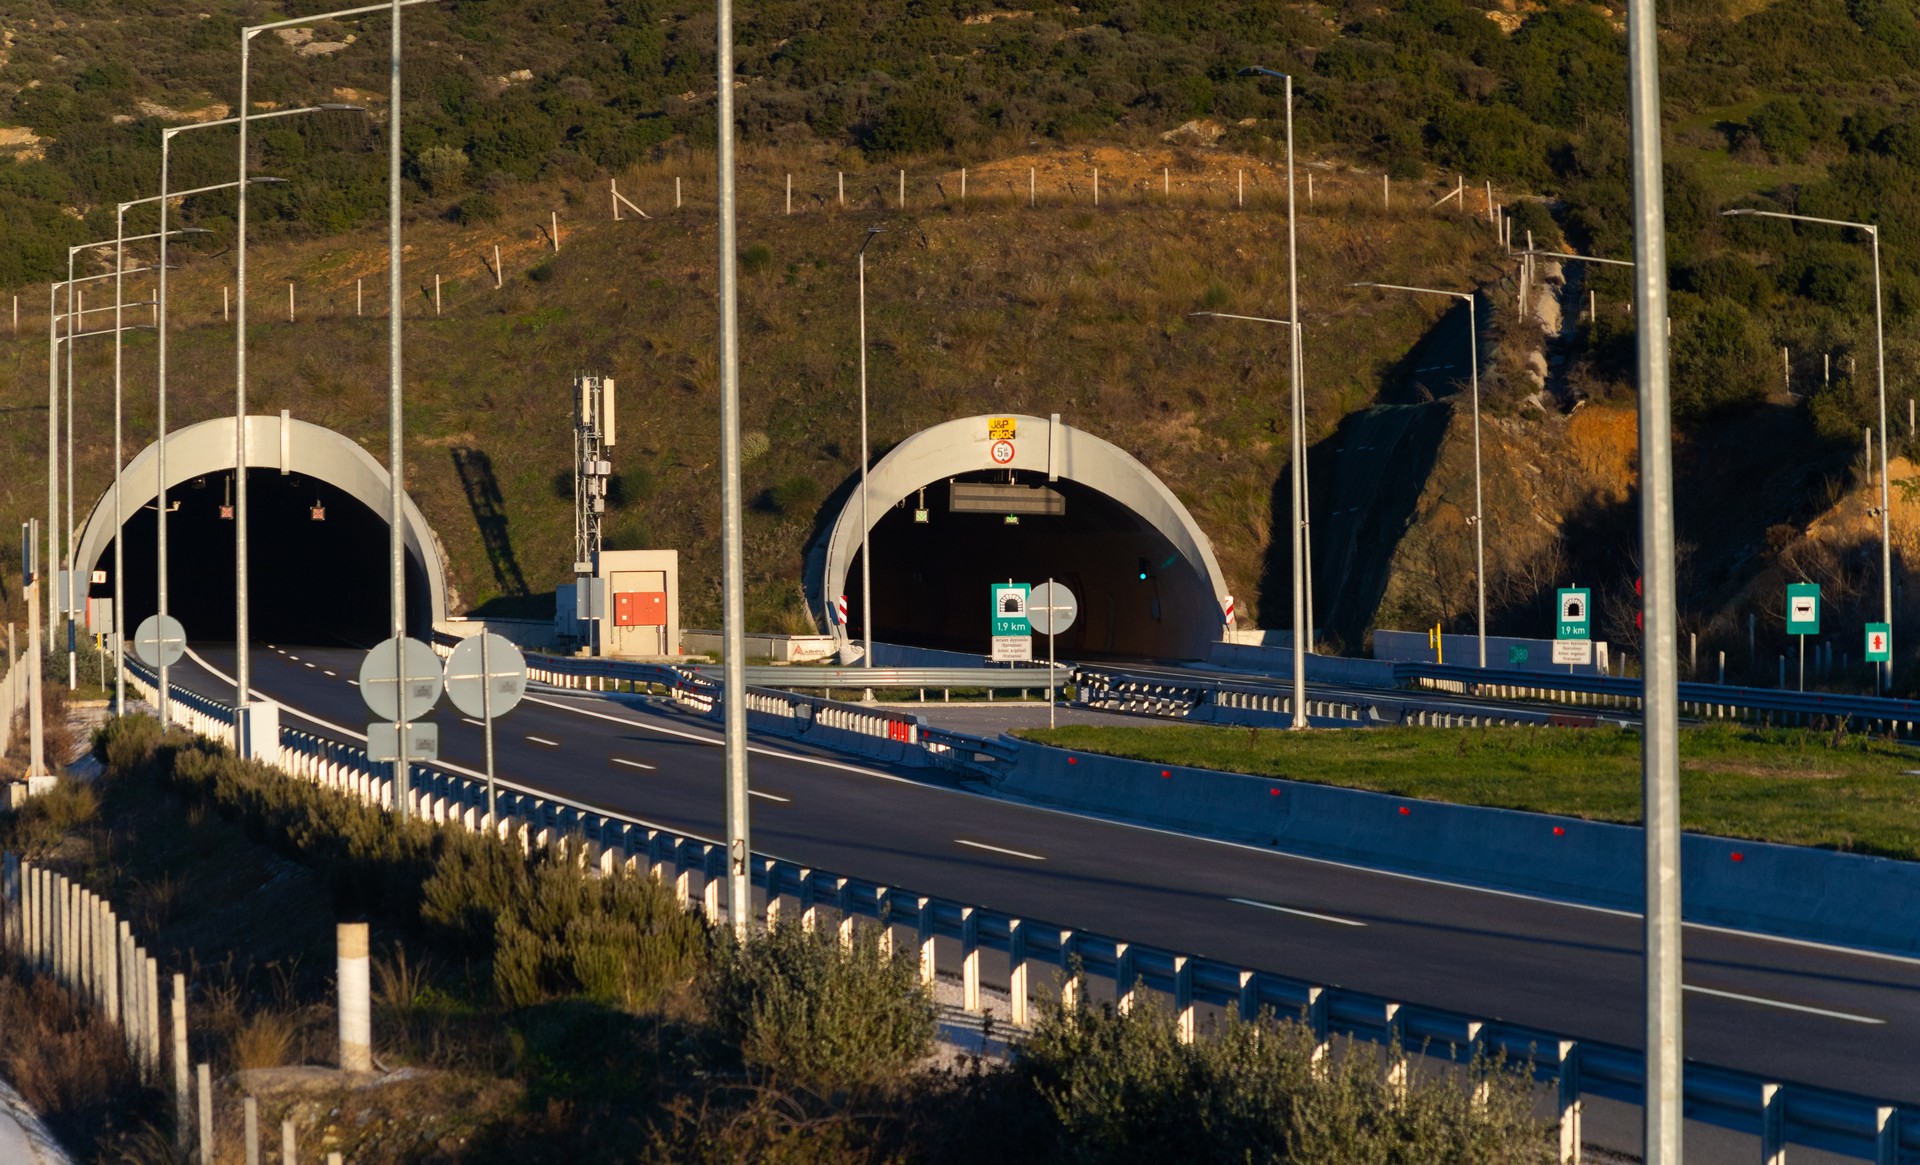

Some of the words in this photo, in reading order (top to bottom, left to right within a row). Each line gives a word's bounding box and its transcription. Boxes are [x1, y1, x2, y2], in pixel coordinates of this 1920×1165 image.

[991, 420, 1009, 429] J&P
[997, 447, 1003, 457] 5
[1011, 622, 1026, 631] km
[1573, 626, 1586, 635] km
